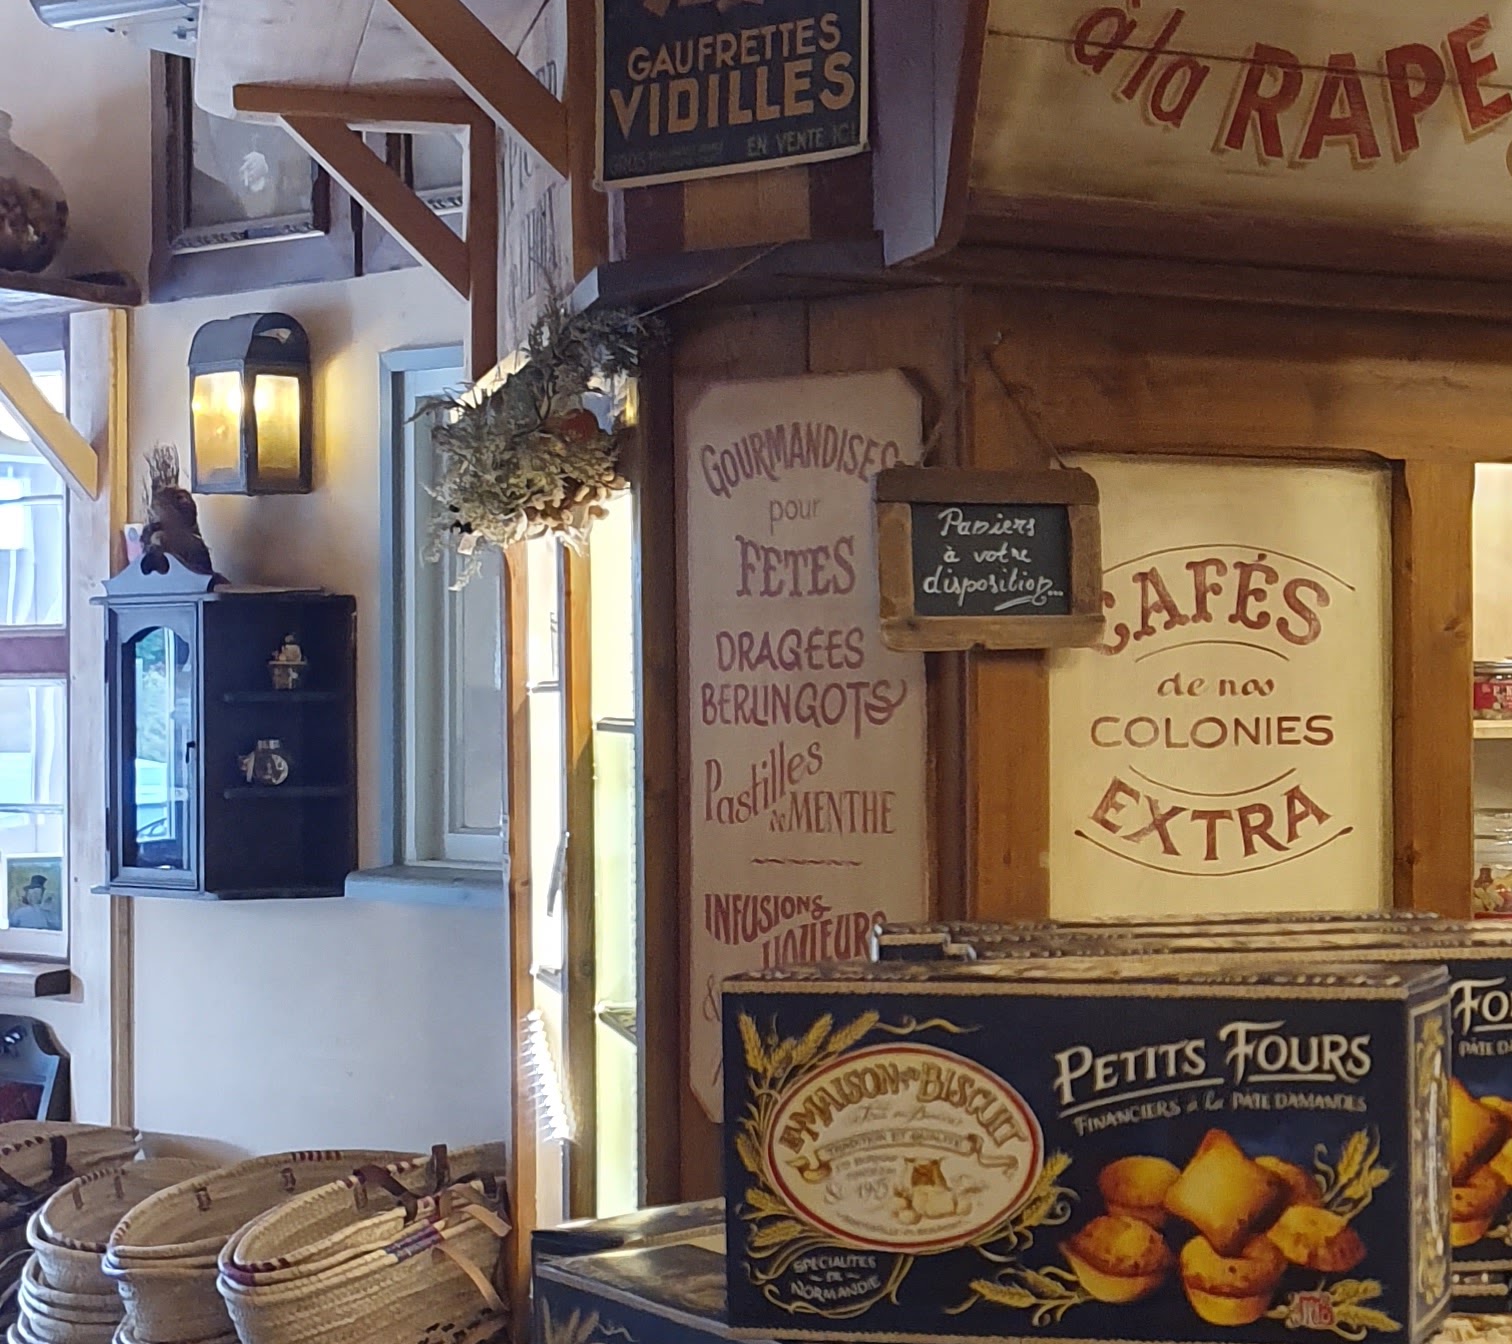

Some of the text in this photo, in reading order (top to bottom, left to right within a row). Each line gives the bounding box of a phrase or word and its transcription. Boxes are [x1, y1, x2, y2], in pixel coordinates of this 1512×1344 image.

[627, 11, 843, 82] GAUFRETTES
[608, 50, 857, 143] VIDILLES
[776, 126, 826, 155] VENTE
[768, 498, 821, 537] pour
[943, 541, 1032, 564] à votre
[700, 677, 908, 738] BERLINGOTS
[1156, 672, 1206, 698] de
[1089, 714, 1336, 750] COLONIES
[704, 739, 824, 825] Pastilles
[785, 789, 897, 837] MENTHE
[1086, 775, 1336, 863] EXTRA
[1053, 1018, 1373, 1106] PETITS FOURS
[791, 1061, 902, 1143] MAISON
[916, 1060, 1029, 1149] BISCUIT
[790, 1275, 882, 1304] NORMANDIE
